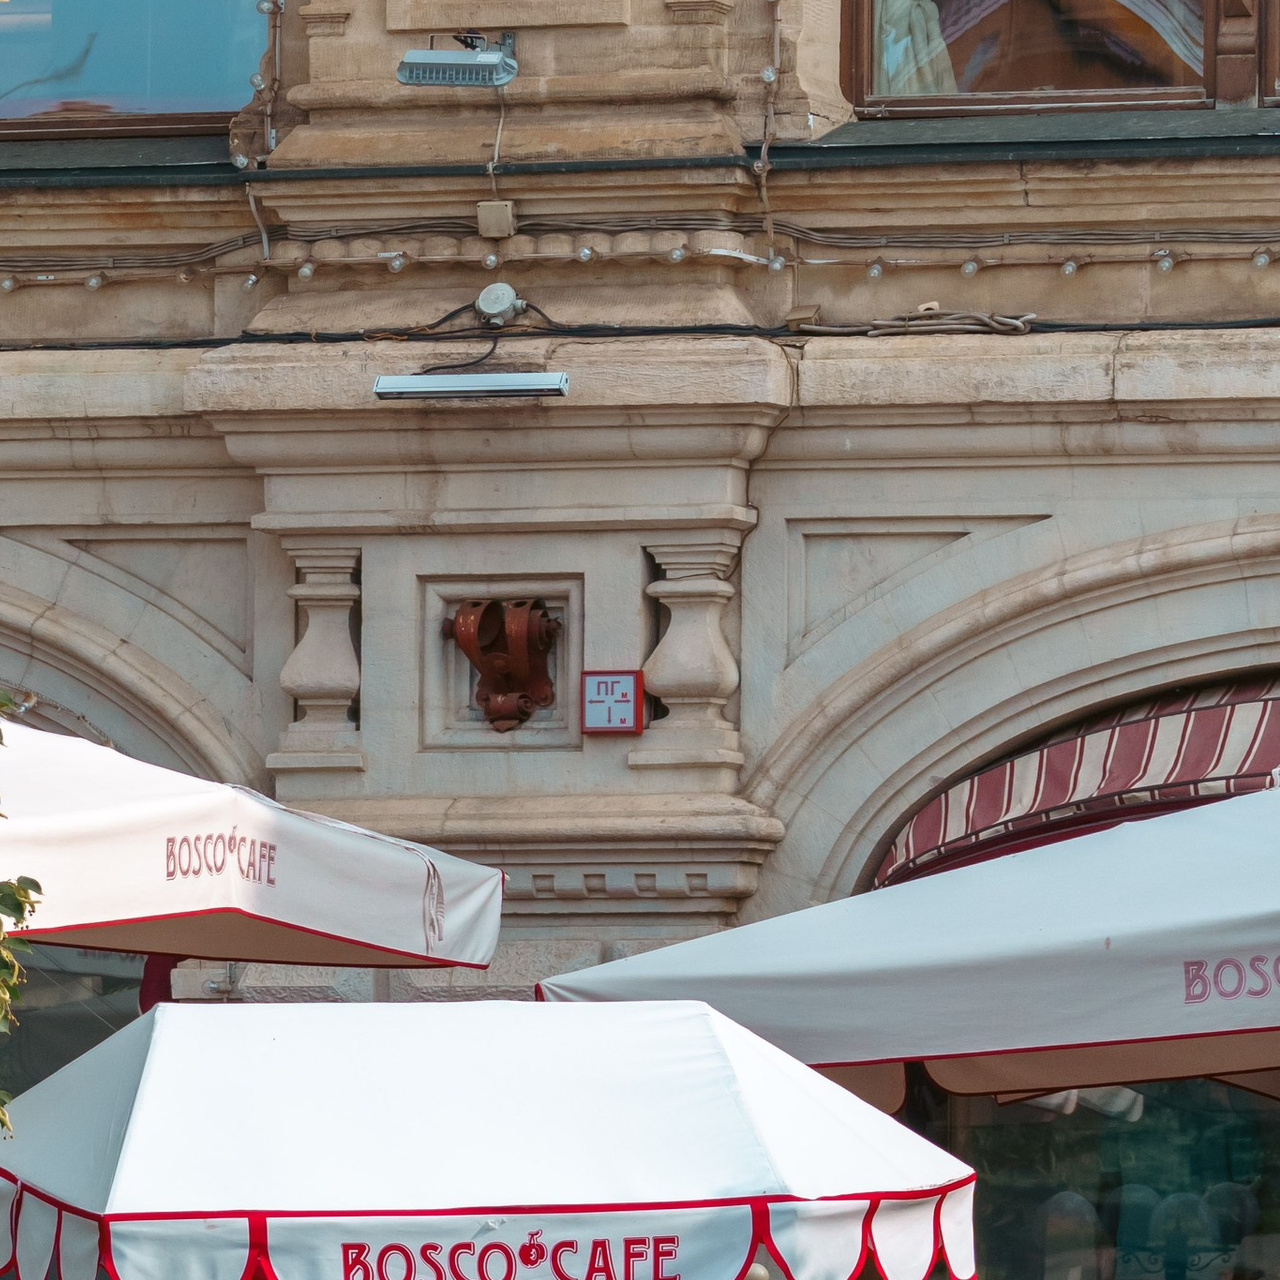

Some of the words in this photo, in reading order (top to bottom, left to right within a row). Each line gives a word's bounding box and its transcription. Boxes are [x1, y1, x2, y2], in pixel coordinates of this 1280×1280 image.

[596, 681, 621, 696] ПГ
[166, 832, 227, 881] BOSCO
[237, 835, 278, 888] CAFE
[1183, 954, 1280, 1005] BOS
